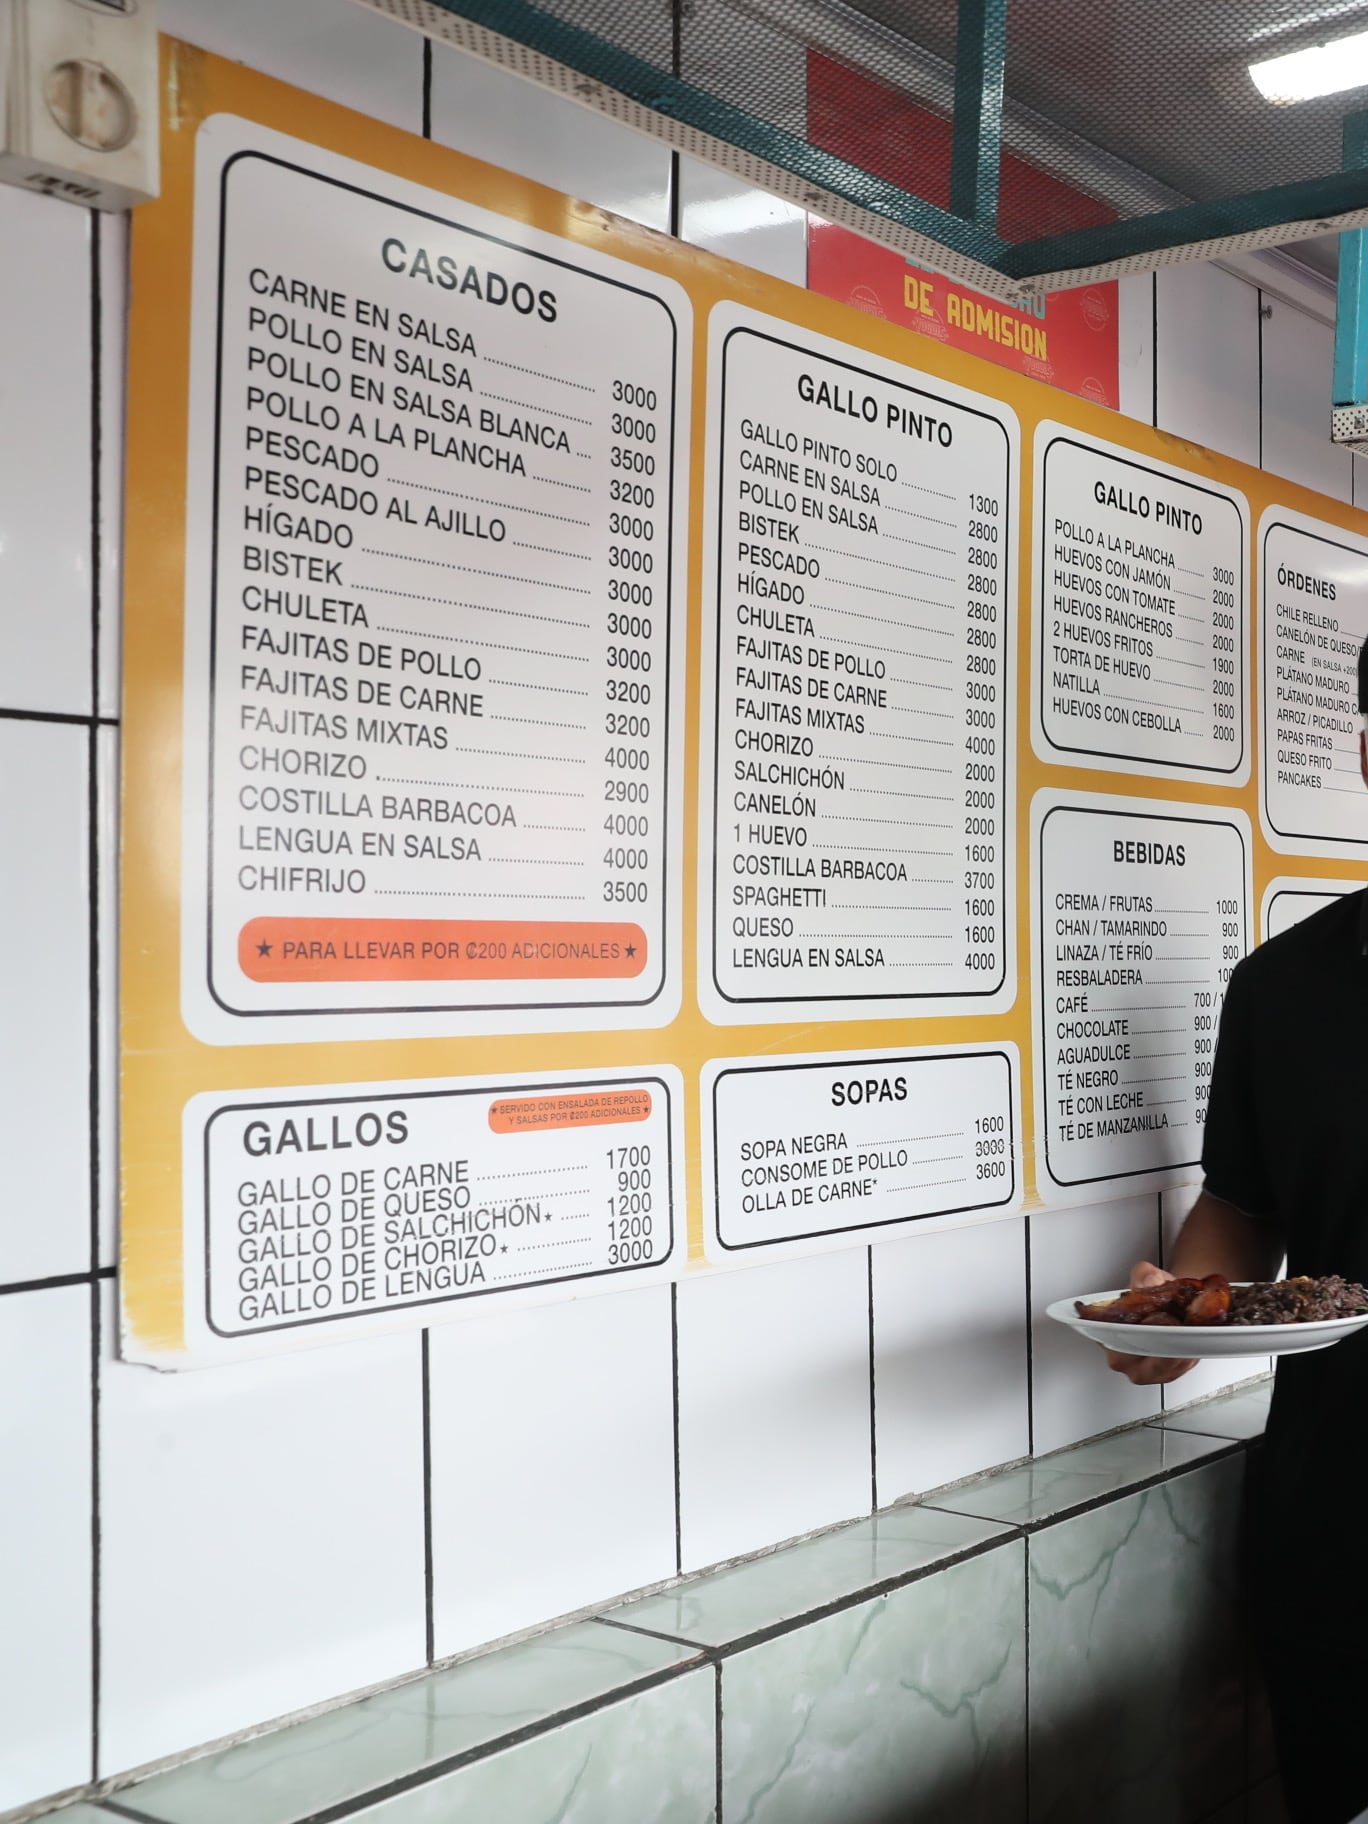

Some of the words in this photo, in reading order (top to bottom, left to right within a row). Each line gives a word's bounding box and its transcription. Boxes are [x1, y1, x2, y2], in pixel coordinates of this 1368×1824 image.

[382, 238, 557, 323] CASADOS
[249, 268, 346, 318] CARNE
[356, 299, 389, 331] EN
[398, 313, 476, 357] SALSA
[612, 380, 657, 411] 3000
[904, 274, 935, 317] DE
[947, 292, 1048, 362] ADMISION
[249, 307, 342, 354] POLLO
[352, 336, 385, 367] EN
[394, 349, 473, 392] SALSA
[611, 413, 656, 444] 3000
[248, 346, 341, 392] POLLO
[351, 374, 384, 405] EN
[393, 386, 472, 428] SALSA
[480, 409, 570, 454] BLANCA
[611, 446, 655, 476] 3500
[798, 374, 878, 423] GALLO
[887, 403, 952, 448] PINTO
[246, 426, 379, 478] PESCADO
[609, 512, 654, 541] 3000
[741, 419, 798, 453] GALLO
[803, 437, 851, 468] PINTO
[856, 454, 897, 482] SOLO
[969, 494, 998, 517] 1300
[1094, 481, 1149, 518] GALLO
[1156, 501, 1202, 535] PINTO
[244, 503, 353, 549] HÍGADO
[608, 579, 652, 607] 3000
[739, 511, 799, 544] BISTEK
[968, 573, 997, 596] 2800
[1055, 544, 1102, 572] HUEVOS
[1105, 559, 1130, 580] CON
[1132, 567, 1170, 591] JAMÓN
[1213, 589, 1234, 608] 2000
[1278, 563, 1336, 601] ÓRDENES
[737, 604, 815, 638] CHULETA
[966, 654, 996, 676] 2800
[1054, 595, 1101, 621] HUEVOS
[1105, 607, 1173, 638] RANCHEROS
[1212, 634, 1234, 653] 2000
[1277, 603, 1300, 622] CHILE
[1303, 611, 1338, 632] RELLENO
[242, 625, 349, 663] FAJITAS
[359, 642, 392, 669] DE
[401, 648, 481, 681] POLLO
[606, 679, 650, 705] 3200
[1053, 645, 1092, 669] TORTA
[1095, 654, 1110, 672] DE
[1113, 658, 1151, 680] HUEVO
[1213, 679, 1234, 697] 2000
[1276, 645, 1305, 664] CARNE
[1322, 660, 1342, 673] SALSA
[1277, 666, 1313, 686] PLÁTANO
[1315, 675, 1350, 694] MADURO
[1053, 671, 1100, 695] NATILLA
[1213, 702, 1234, 720] 1600
[241, 705, 348, 740] FAJITAS
[357, 717, 448, 750] MIXTAS
[604, 747, 649, 771] 4000
[1277, 749, 1307, 766] QUESO
[1309, 754, 1332, 770] FRITO
[1278, 728, 1303, 745] PAPAS
[1306, 734, 1332, 750] FRITAS
[735, 760, 844, 790] SALCHICHÓN
[965, 790, 995, 809] 2000
[1278, 770, 1322, 789] PANCAKES
[734, 823, 740, 842] 1
[749, 824, 807, 847] HUEVO
[965, 844, 994, 863] 1600
[1114, 840, 1185, 866] BEBIDAS
[238, 865, 366, 894] CHIFRIJO
[603, 881, 648, 903] 3500
[733, 885, 826, 907] SPAGHETTI
[965, 899, 994, 916] 1600
[1055, 893, 1099, 911] CREMA
[1110, 895, 1153, 912] FRUTAS
[1216, 900, 1238, 915] 1000
[283, 941, 337, 959] PARA
[344, 941, 415, 959] LLEVAR
[422, 942, 459, 959] POR
[512, 943, 620, 959] ADICIONALES
[1056, 919, 1090, 936] CHAN
[1100, 920, 1167, 936] TAMARINDO
[1222, 922, 1238, 937] 900
[1056, 945, 1099, 961] LINAZA
[1109, 941, 1124, 961] TÉ
[1127, 941, 1153, 960] FRÍO
[1223, 945, 1239, 960] 900
[733, 948, 803, 968] LENGUA
[809, 948, 829, 967] EN
[835, 948, 885, 967] SALSA
[965, 953, 995, 970] 4000
[831, 1077, 907, 1106] SOPAS
[1057, 1069, 1073, 1091] TÉ
[1077, 1070, 1118, 1088] NEGRO
[1195, 1061, 1211, 1078] 900
[500, 1103, 536, 1114] SERVIDO
[538, 1102, 555, 1111] CON
[558, 1098, 599, 1110] ENSALADA
[601, 1097, 612, 1106] DE
[613, 1094, 649, 1105] REPOLLO
[508, 1117, 514, 1125] Y
[517, 1113, 548, 1125] SALSAS
[550, 1112, 567, 1121] POR
[590, 1106, 641, 1118] ADICIONALES
[243, 1110, 408, 1157] GALLOS
[741, 1139, 786, 1161] SOPA
[792, 1132, 848, 1155] NEGRA
[975, 1116, 1004, 1134] 1600
[238, 1174, 331, 1207] GALLO
[341, 1169, 375, 1196] DE
[384, 1160, 469, 1191] CARNE
[606, 1145, 651, 1169] 1700
[742, 1159, 827, 1187] CONSOME
[832, 1156, 853, 1175] DE
[858, 1149, 908, 1171] POLLO
[238, 1201, 331, 1236] GALLO
[342, 1196, 375, 1223] DE
[384, 1185, 471, 1217] QUESO
[618, 1168, 651, 1192] 900
[238, 1229, 331, 1264] GALLO
[341, 1223, 375, 1250] DE
[384, 1197, 540, 1244] SALCHICHÓN
[607, 1192, 652, 1217] 1200
